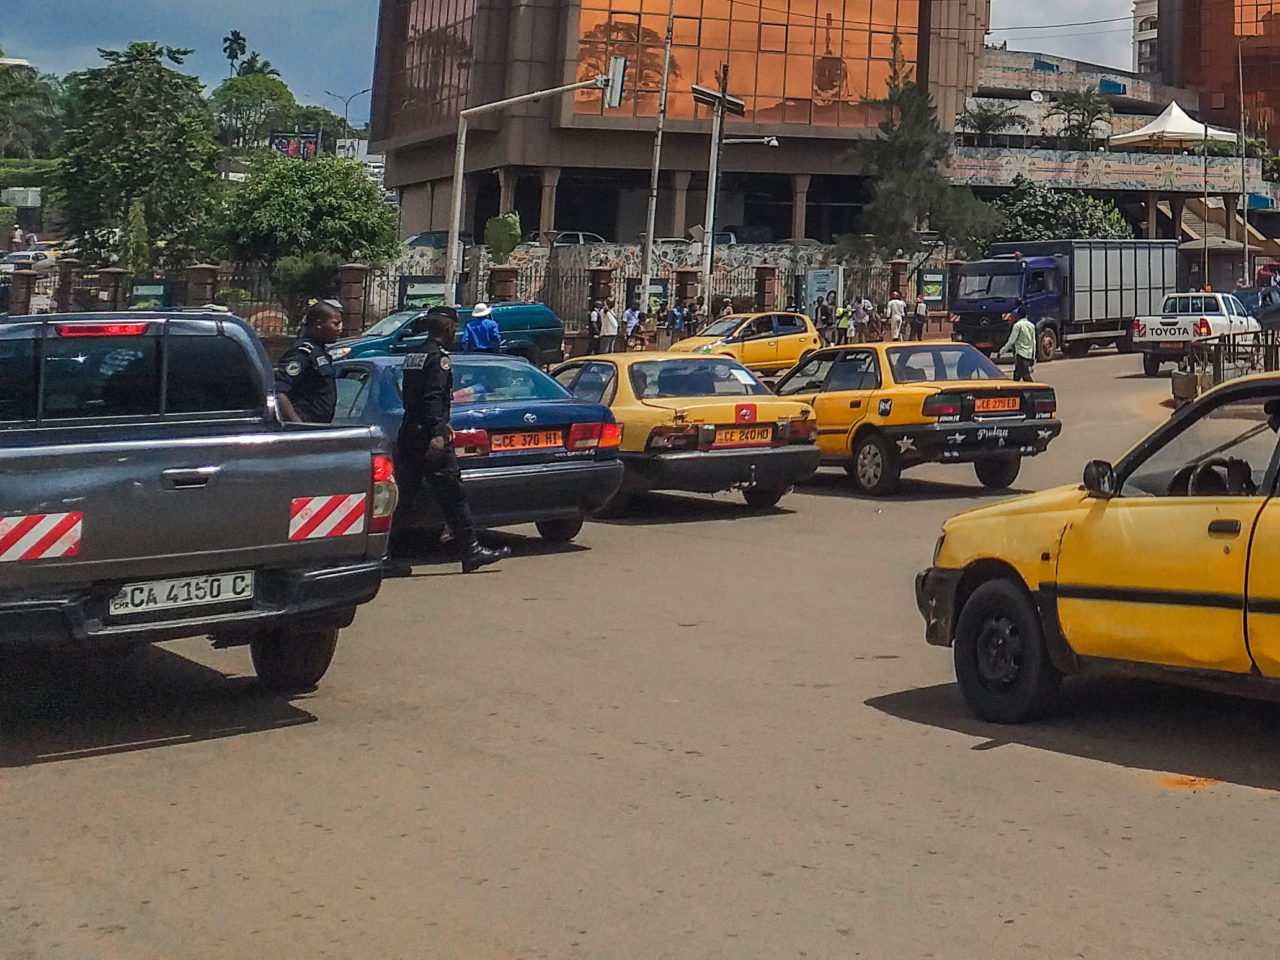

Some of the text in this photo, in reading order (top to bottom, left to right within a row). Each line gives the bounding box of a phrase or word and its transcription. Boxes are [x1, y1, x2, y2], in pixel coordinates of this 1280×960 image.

[1149, 327, 1189, 336] TOYOTA
[502, 433, 558, 448] CE 370 HI
[725, 431, 736, 441] CE
[739, 430, 756, 440] 240
[130, 575, 246, 607] CA 4150 C
[113, 602, 130, 610] CMR
